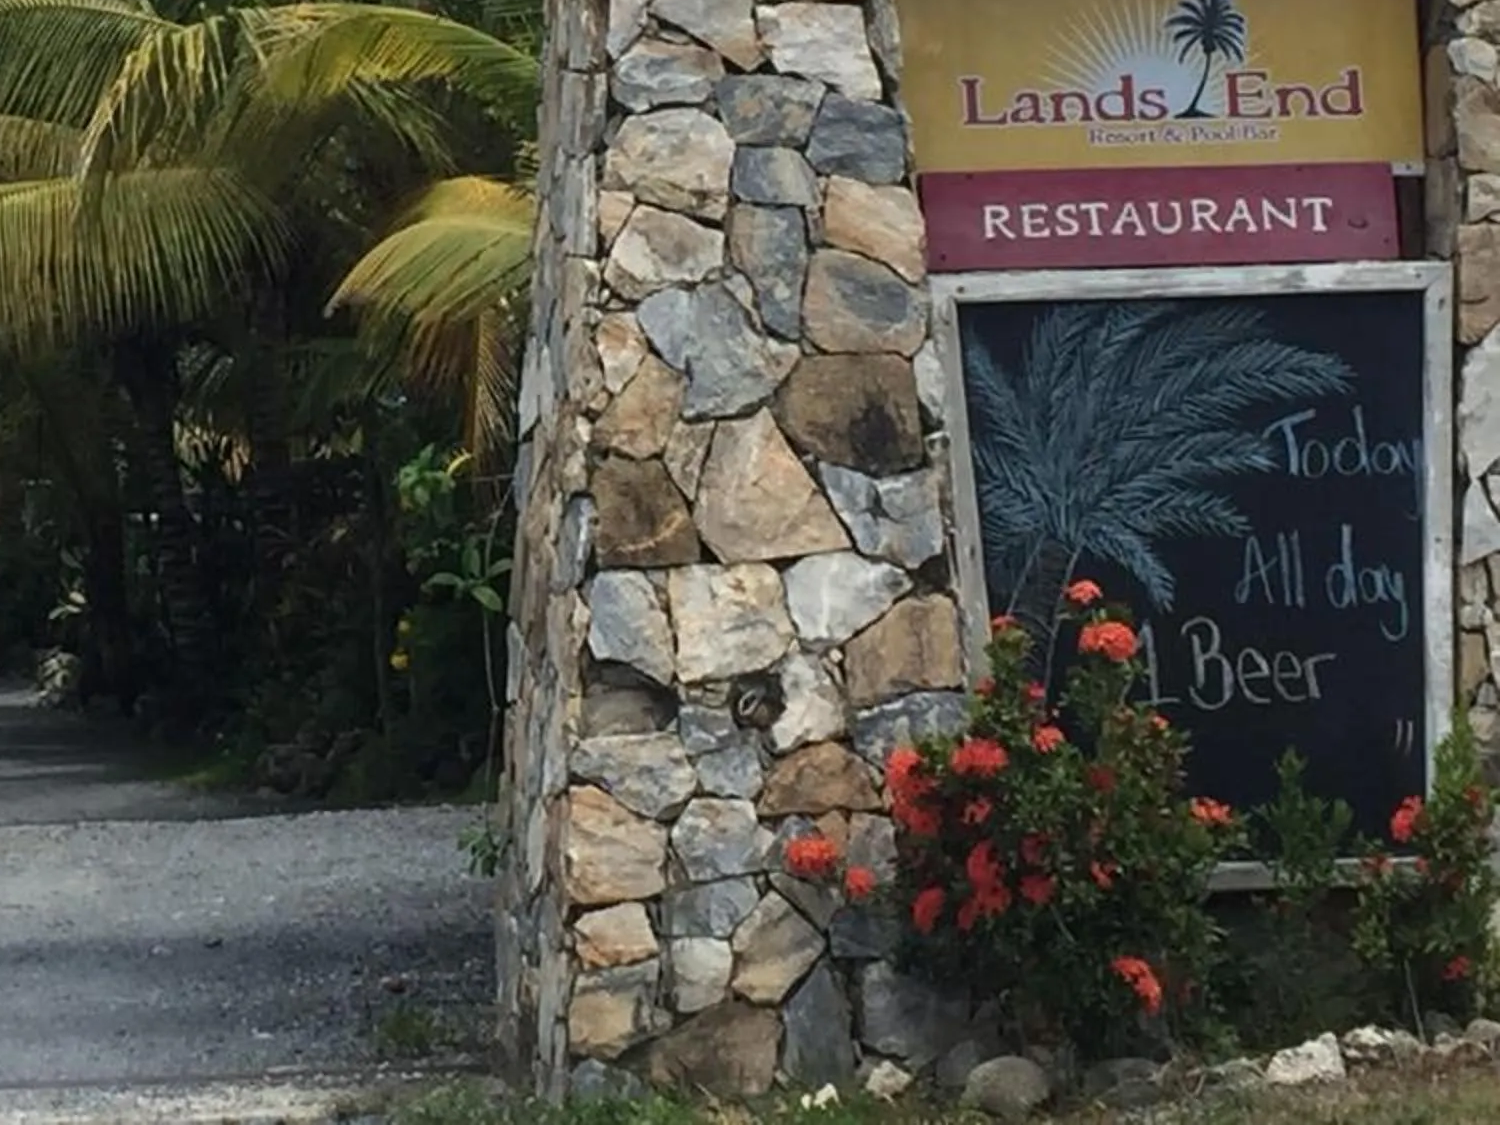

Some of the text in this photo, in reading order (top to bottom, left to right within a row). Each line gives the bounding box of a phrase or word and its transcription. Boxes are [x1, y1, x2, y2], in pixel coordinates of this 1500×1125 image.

[960, 69, 1364, 125] Lands End
[1089, 128, 1157, 145] Resort
[1191, 125, 1236, 142] Pool
[1242, 125, 1278, 141] Bar
[983, 196, 1334, 240] RESTAURANT
[1234, 522, 1409, 642] All day
[1181, 615, 1338, 711] Beer
